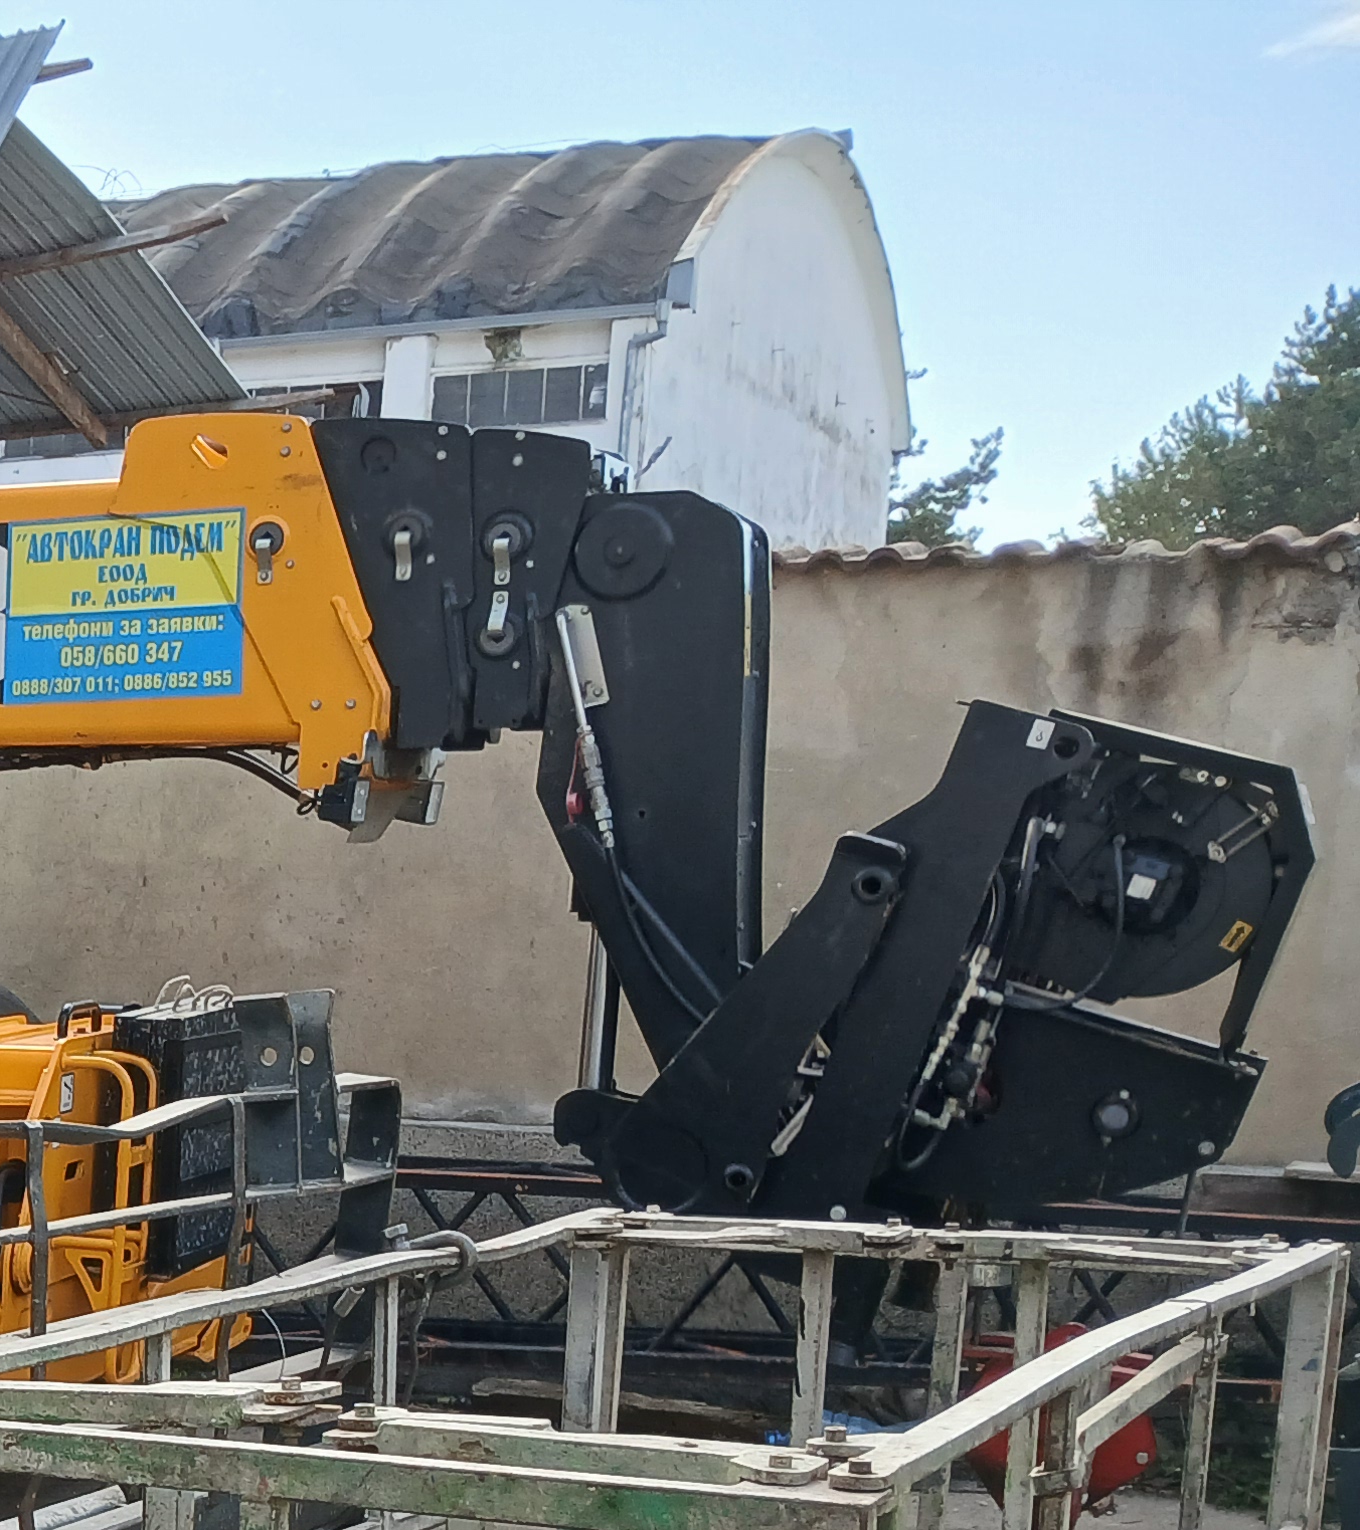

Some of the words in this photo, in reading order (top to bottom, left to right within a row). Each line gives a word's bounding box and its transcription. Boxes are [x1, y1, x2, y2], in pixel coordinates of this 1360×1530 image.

[16, 526, 141, 564] "АВТОКРАН
[149, 519, 237, 561] ПОДЕМ"
[97, 563, 147, 585] ЕООД
[71, 591, 96, 607] ГР.
[104, 586, 176, 608] ДОБРИЧ
[23, 618, 114, 642] телефони
[119, 618, 141, 636] за
[147, 614, 225, 636] заявки:
[60, 644, 140, 669] 058/660
[145, 641, 183, 663] 347
[12, 675, 81, 697] 0888/307
[85, 676, 120, 694] 011;
[123, 671, 198, 692] 0886/852
[202, 670, 232, 687] 955
